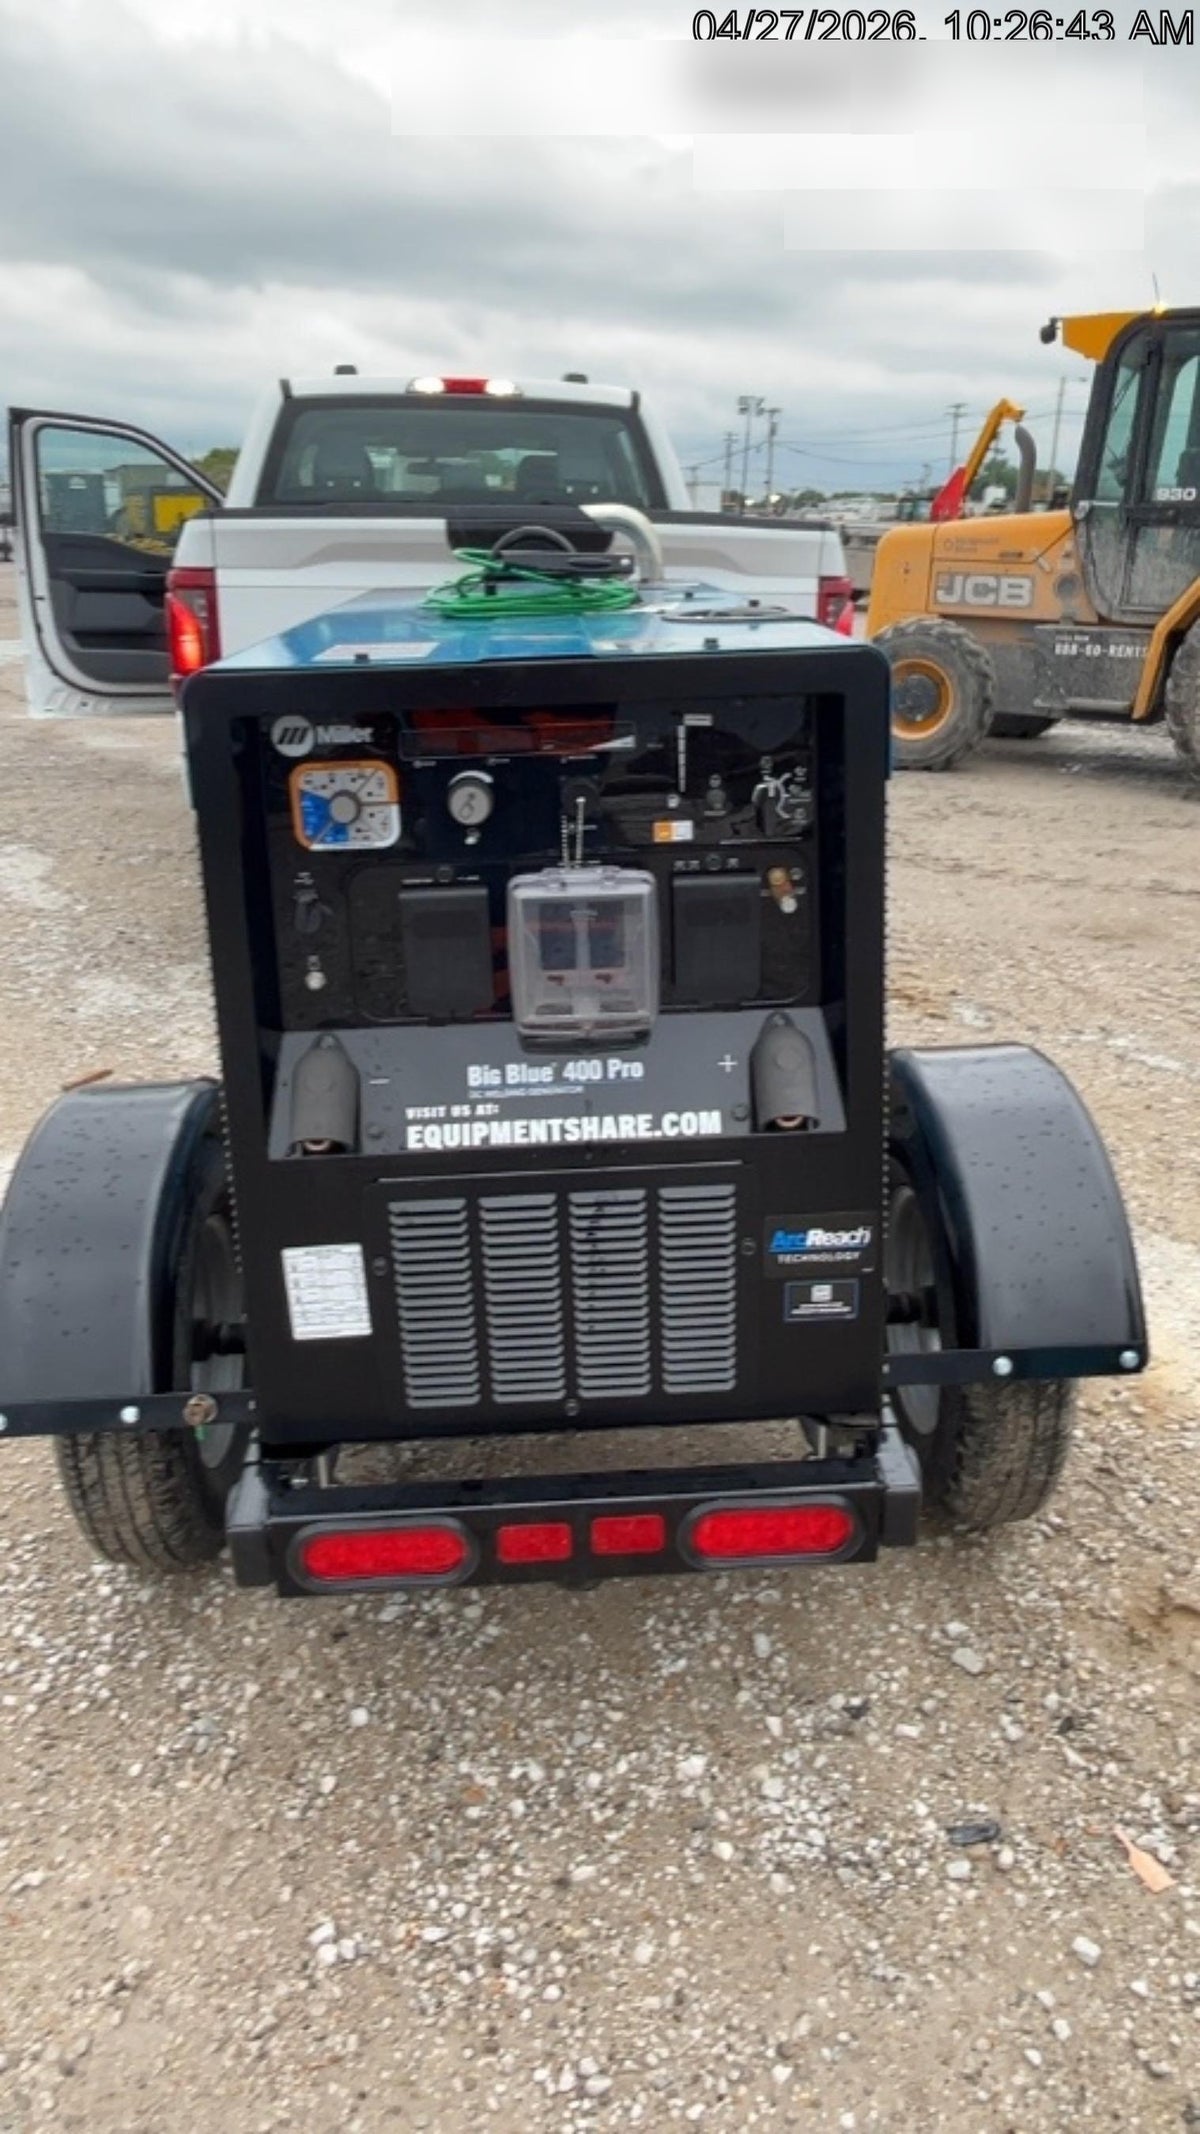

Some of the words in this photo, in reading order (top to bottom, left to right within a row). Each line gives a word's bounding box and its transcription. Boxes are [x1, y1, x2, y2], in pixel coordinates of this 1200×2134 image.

[936, 575, 1032, 606] JCB
[315, 724, 375, 745] Miller
[505, 1062, 554, 1085] Blue
[562, 1058, 602, 1081] 400
[606, 1056, 645, 1080] Pro
[405, 1106, 447, 1120] VISIT
[450, 1104, 472, 1117] US
[474, 1102, 500, 1116] AT:
[406, 1109, 723, 1150] EQUIPMENTSHARE.COM
[769, 1226, 873, 1251] ArcReach
